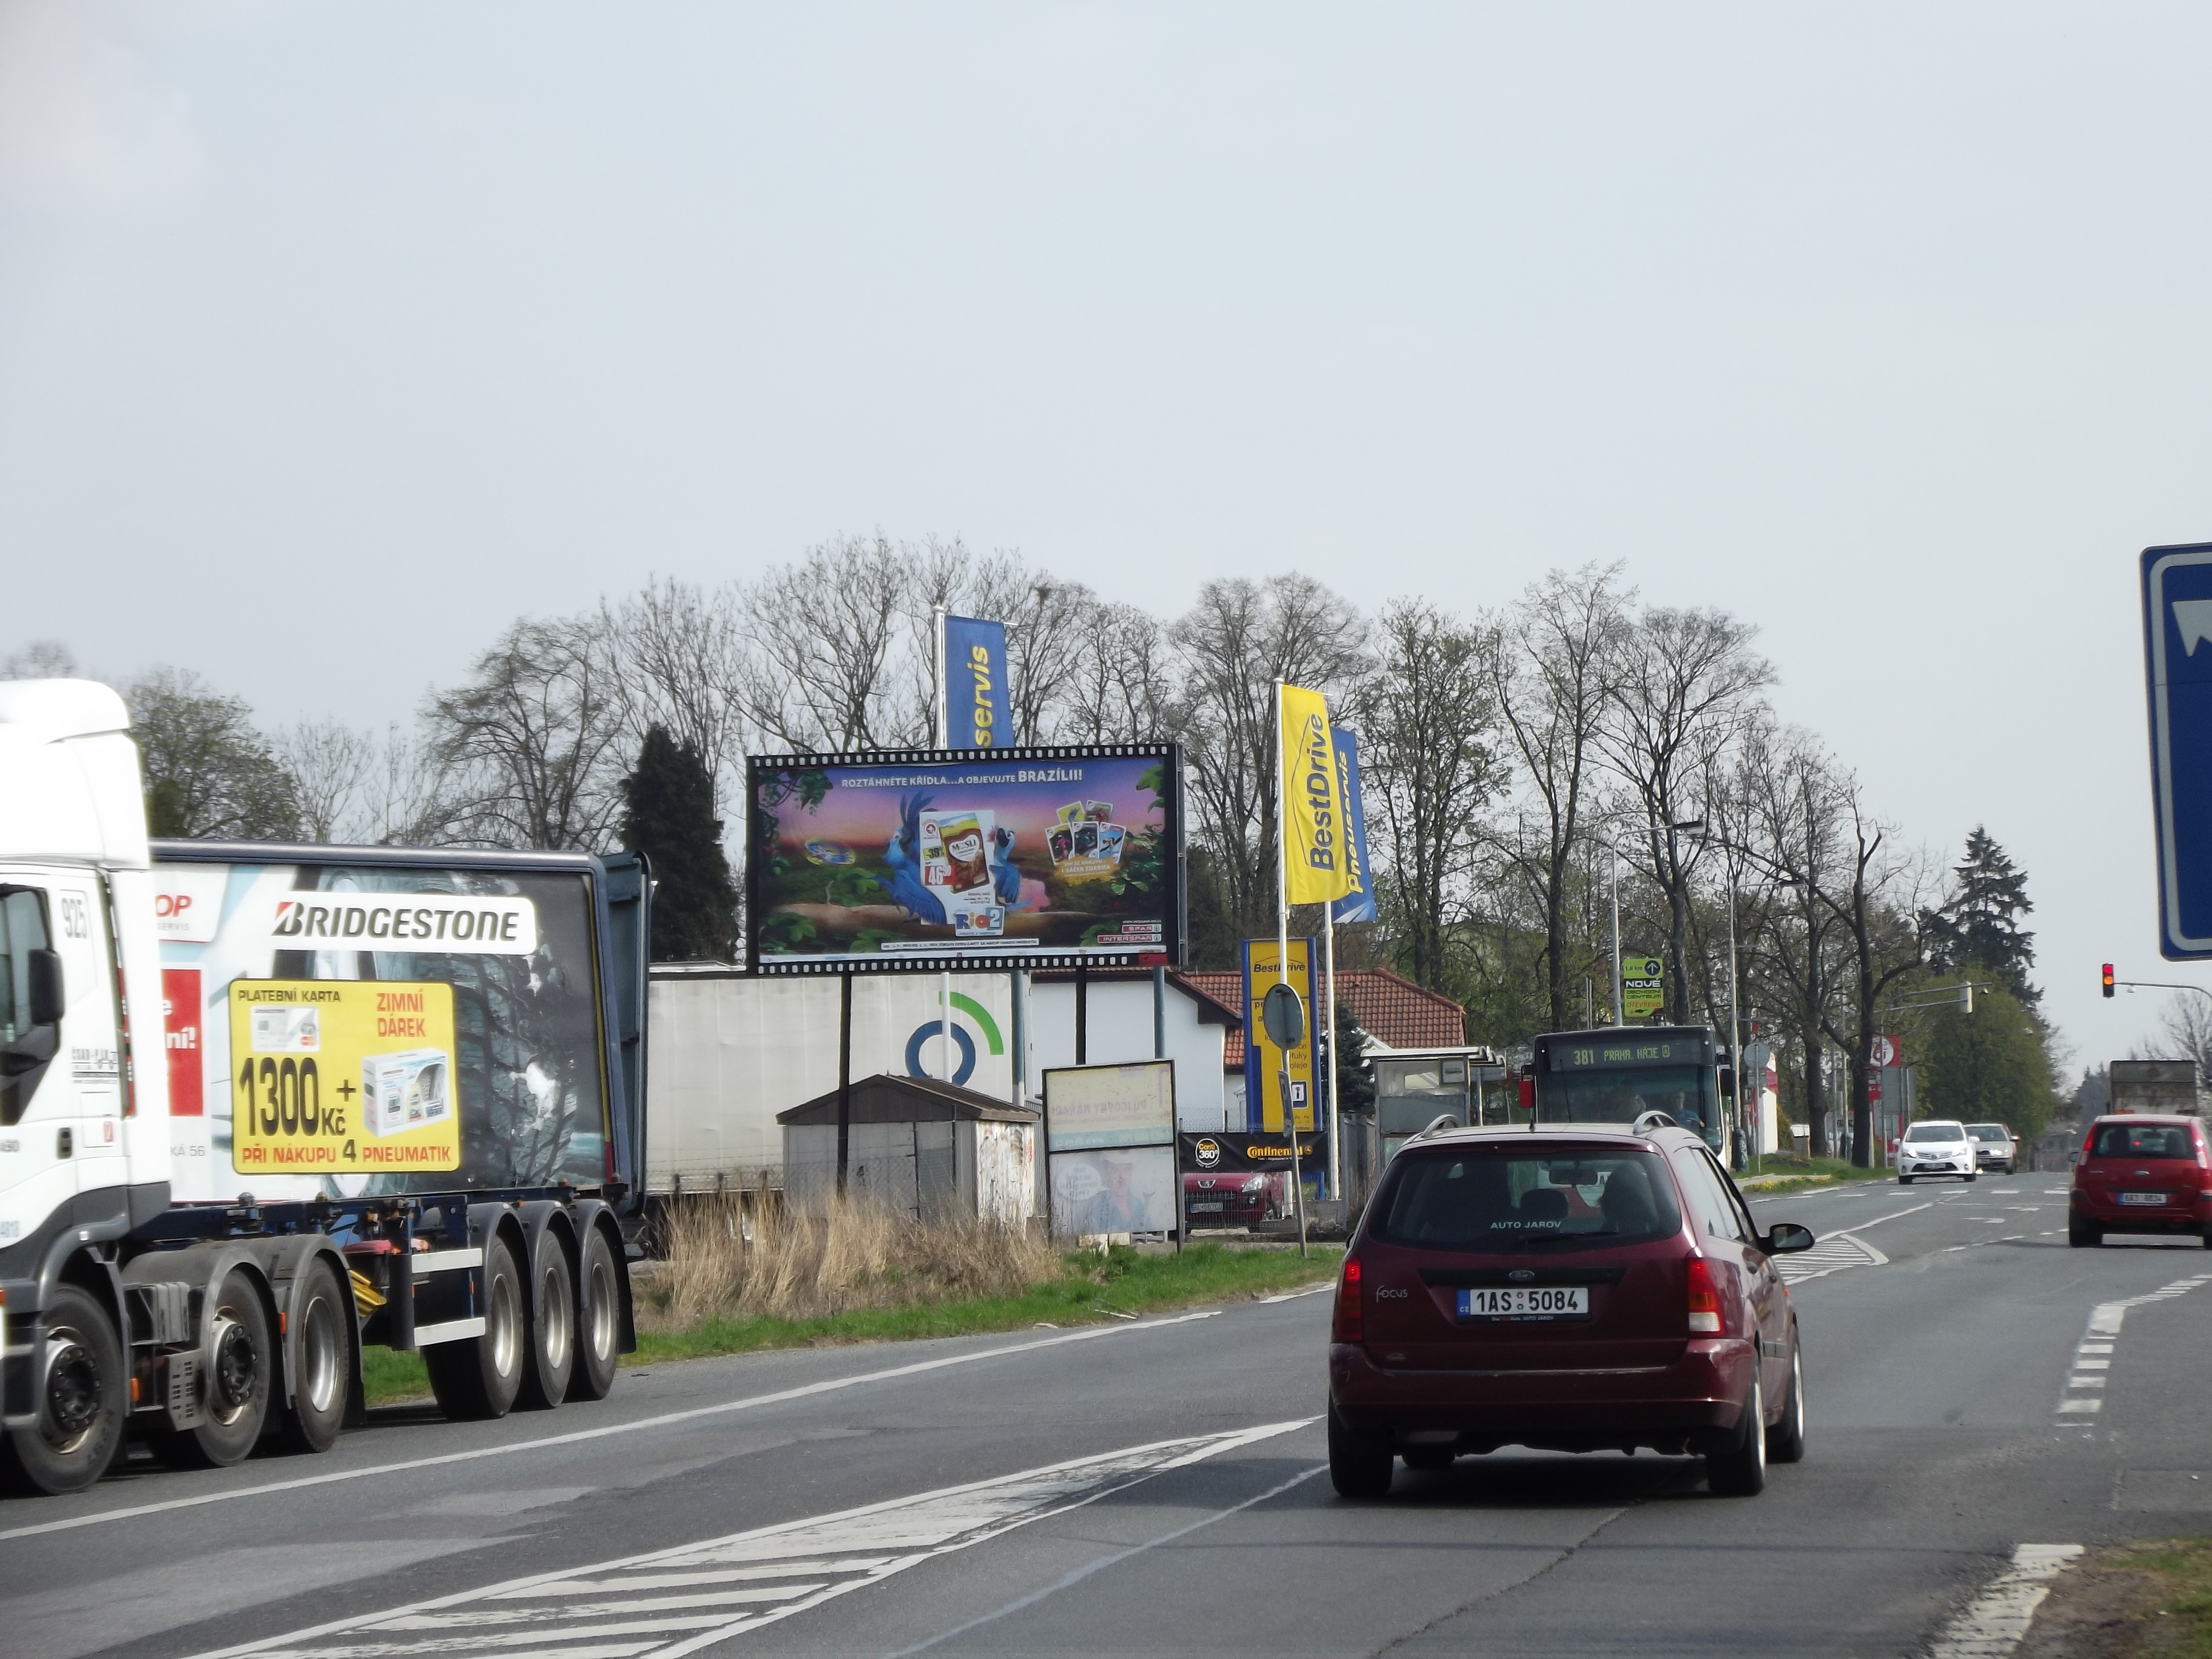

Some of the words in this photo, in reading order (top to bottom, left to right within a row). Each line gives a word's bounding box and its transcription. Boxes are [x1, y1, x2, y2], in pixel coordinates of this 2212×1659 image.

[966, 645, 993, 747] servis
[966, 775, 1016, 784] OBJEVUJTE
[1018, 768, 1082, 783] BRAZÍLII!
[1306, 713, 1335, 871] BestDrive
[271, 901, 519, 941] BRIDGESTONE
[1254, 963, 1305, 972] Bestrive
[238, 987, 297, 1002] PLATEBNÍ
[301, 990, 341, 1003] KARTA
[376, 988, 424, 1013] ZIMNÍ
[377, 1013, 426, 1038] DÁREK
[1573, 1049, 1594, 1066] 381
[239, 1057, 319, 1136] 1300
[321, 1108, 346, 1136] Kč
[189, 1146, 205, 1157] 56
[241, 1144, 266, 1164] PŘI
[272, 1144, 336, 1163] NÁKUPU
[341, 1139, 357, 1163] 4
[362, 1146, 451, 1163] PNEUMATIK
[1476, 1291, 1512, 1312] 1AS
[1528, 1290, 1579, 1311] 5084
